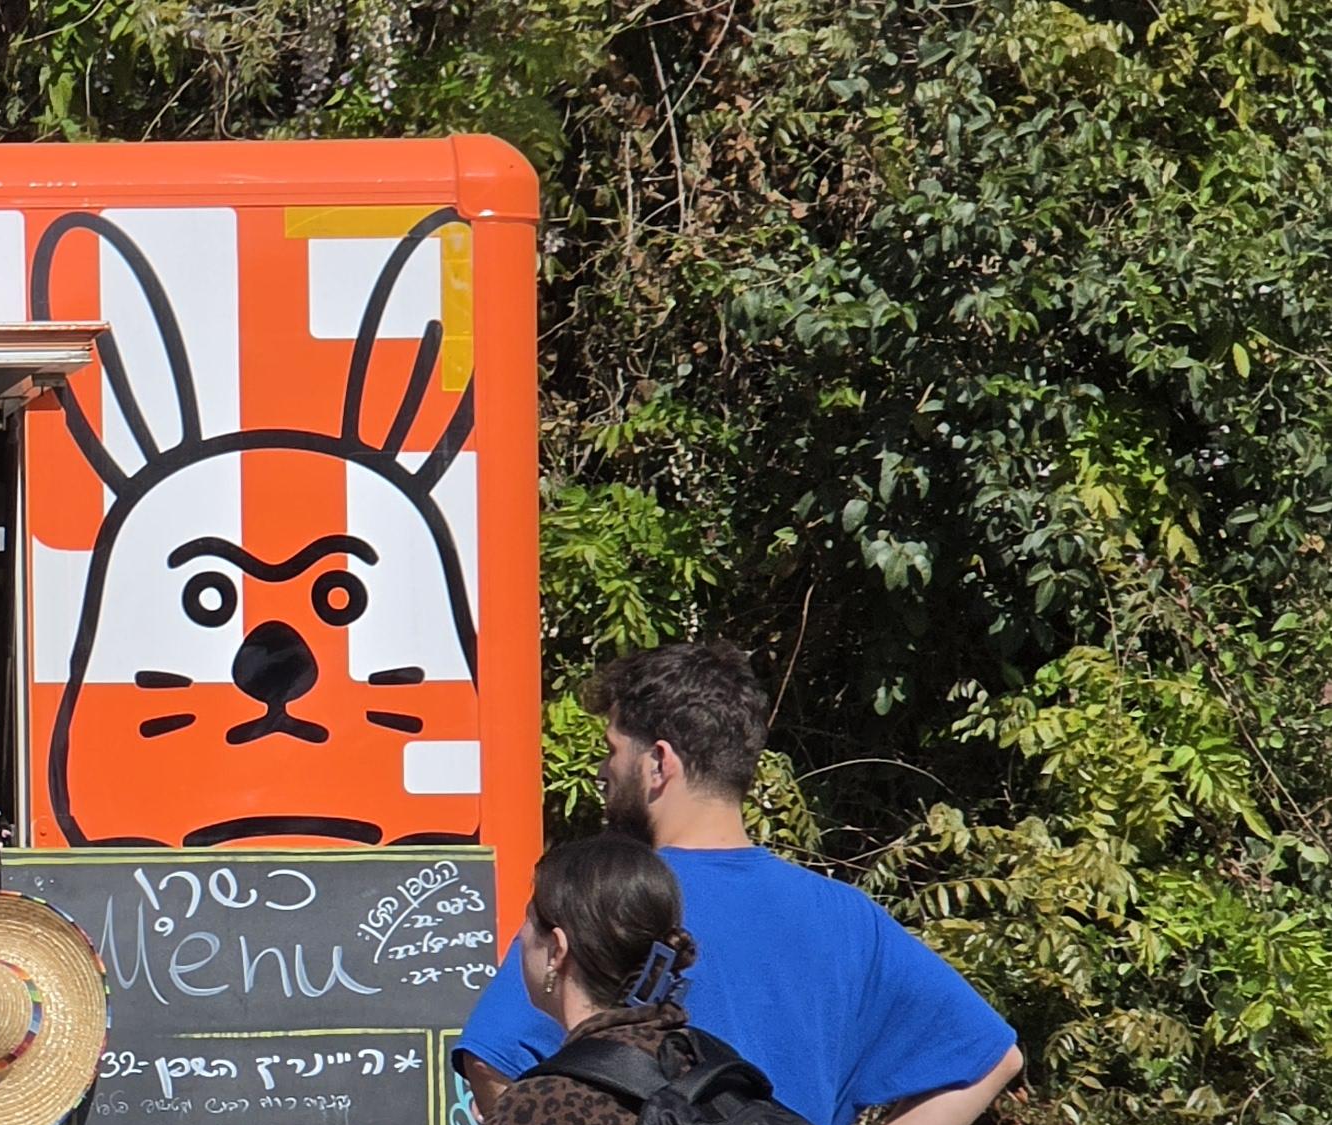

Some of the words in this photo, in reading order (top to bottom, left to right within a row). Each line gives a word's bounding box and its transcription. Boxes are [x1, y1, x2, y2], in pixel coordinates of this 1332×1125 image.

[397, 860, 459, 908] השפן
[99, 895, 383, 1006] Menu
[154, 1056, 238, 1100] השפן
